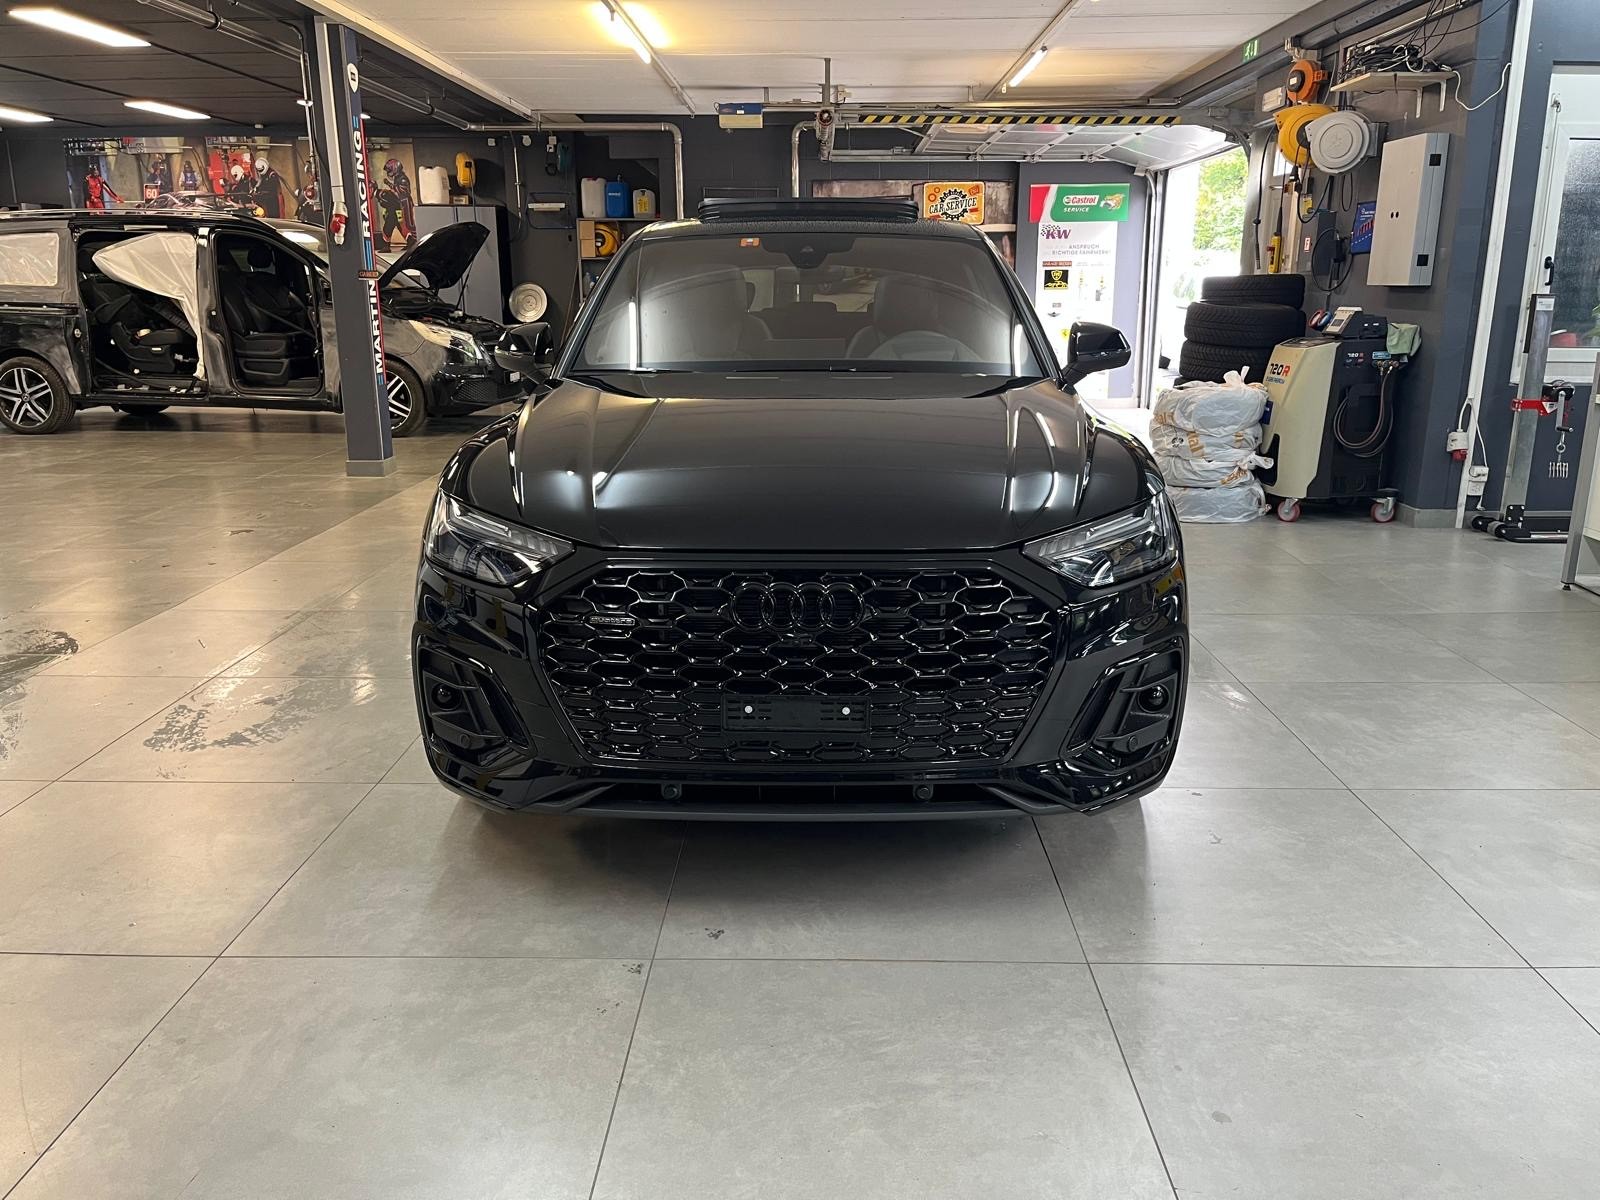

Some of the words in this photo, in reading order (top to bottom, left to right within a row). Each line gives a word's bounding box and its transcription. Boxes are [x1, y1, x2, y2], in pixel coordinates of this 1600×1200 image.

[354, 131, 370, 238] RACING
[145, 189, 158, 199] 60
[1071, 196, 1097, 204] Castrol
[929, 203, 945, 214] CAR
[946, 197, 977, 211] SERVICE
[368, 280, 383, 373] MARTIN
